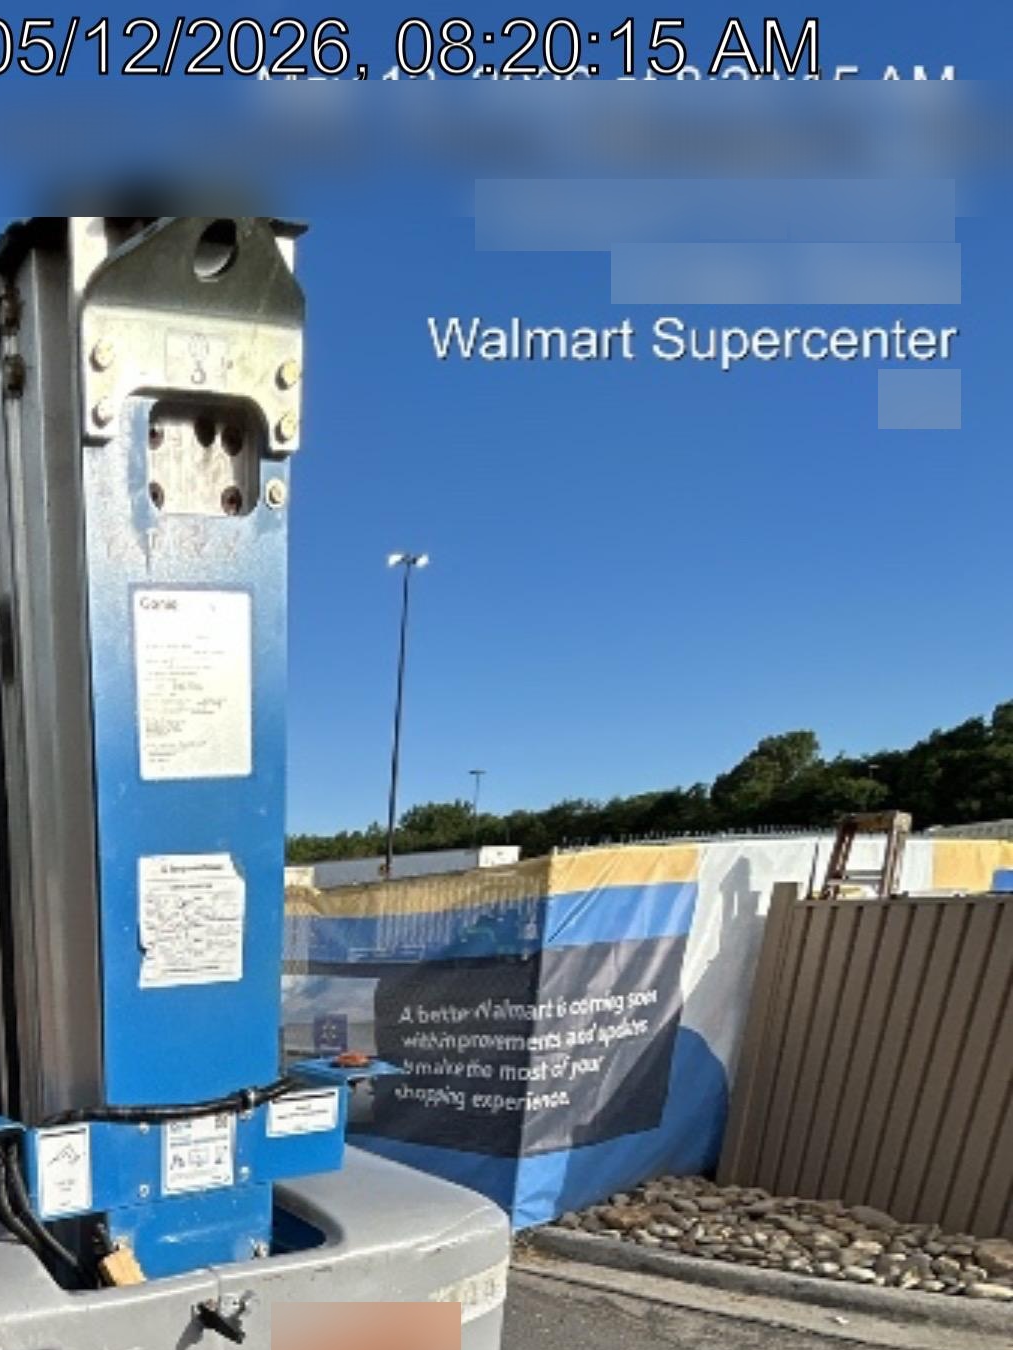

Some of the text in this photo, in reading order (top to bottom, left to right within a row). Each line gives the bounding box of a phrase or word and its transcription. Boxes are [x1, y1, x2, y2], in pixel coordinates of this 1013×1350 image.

[397, 1005, 414, 1024] A
[417, 1004, 472, 1024] better
[474, 998, 554, 1022] Walmart
[568, 991, 625, 1016] coming
[499, 1060, 548, 1081] most
[394, 1083, 466, 1111] shopping
